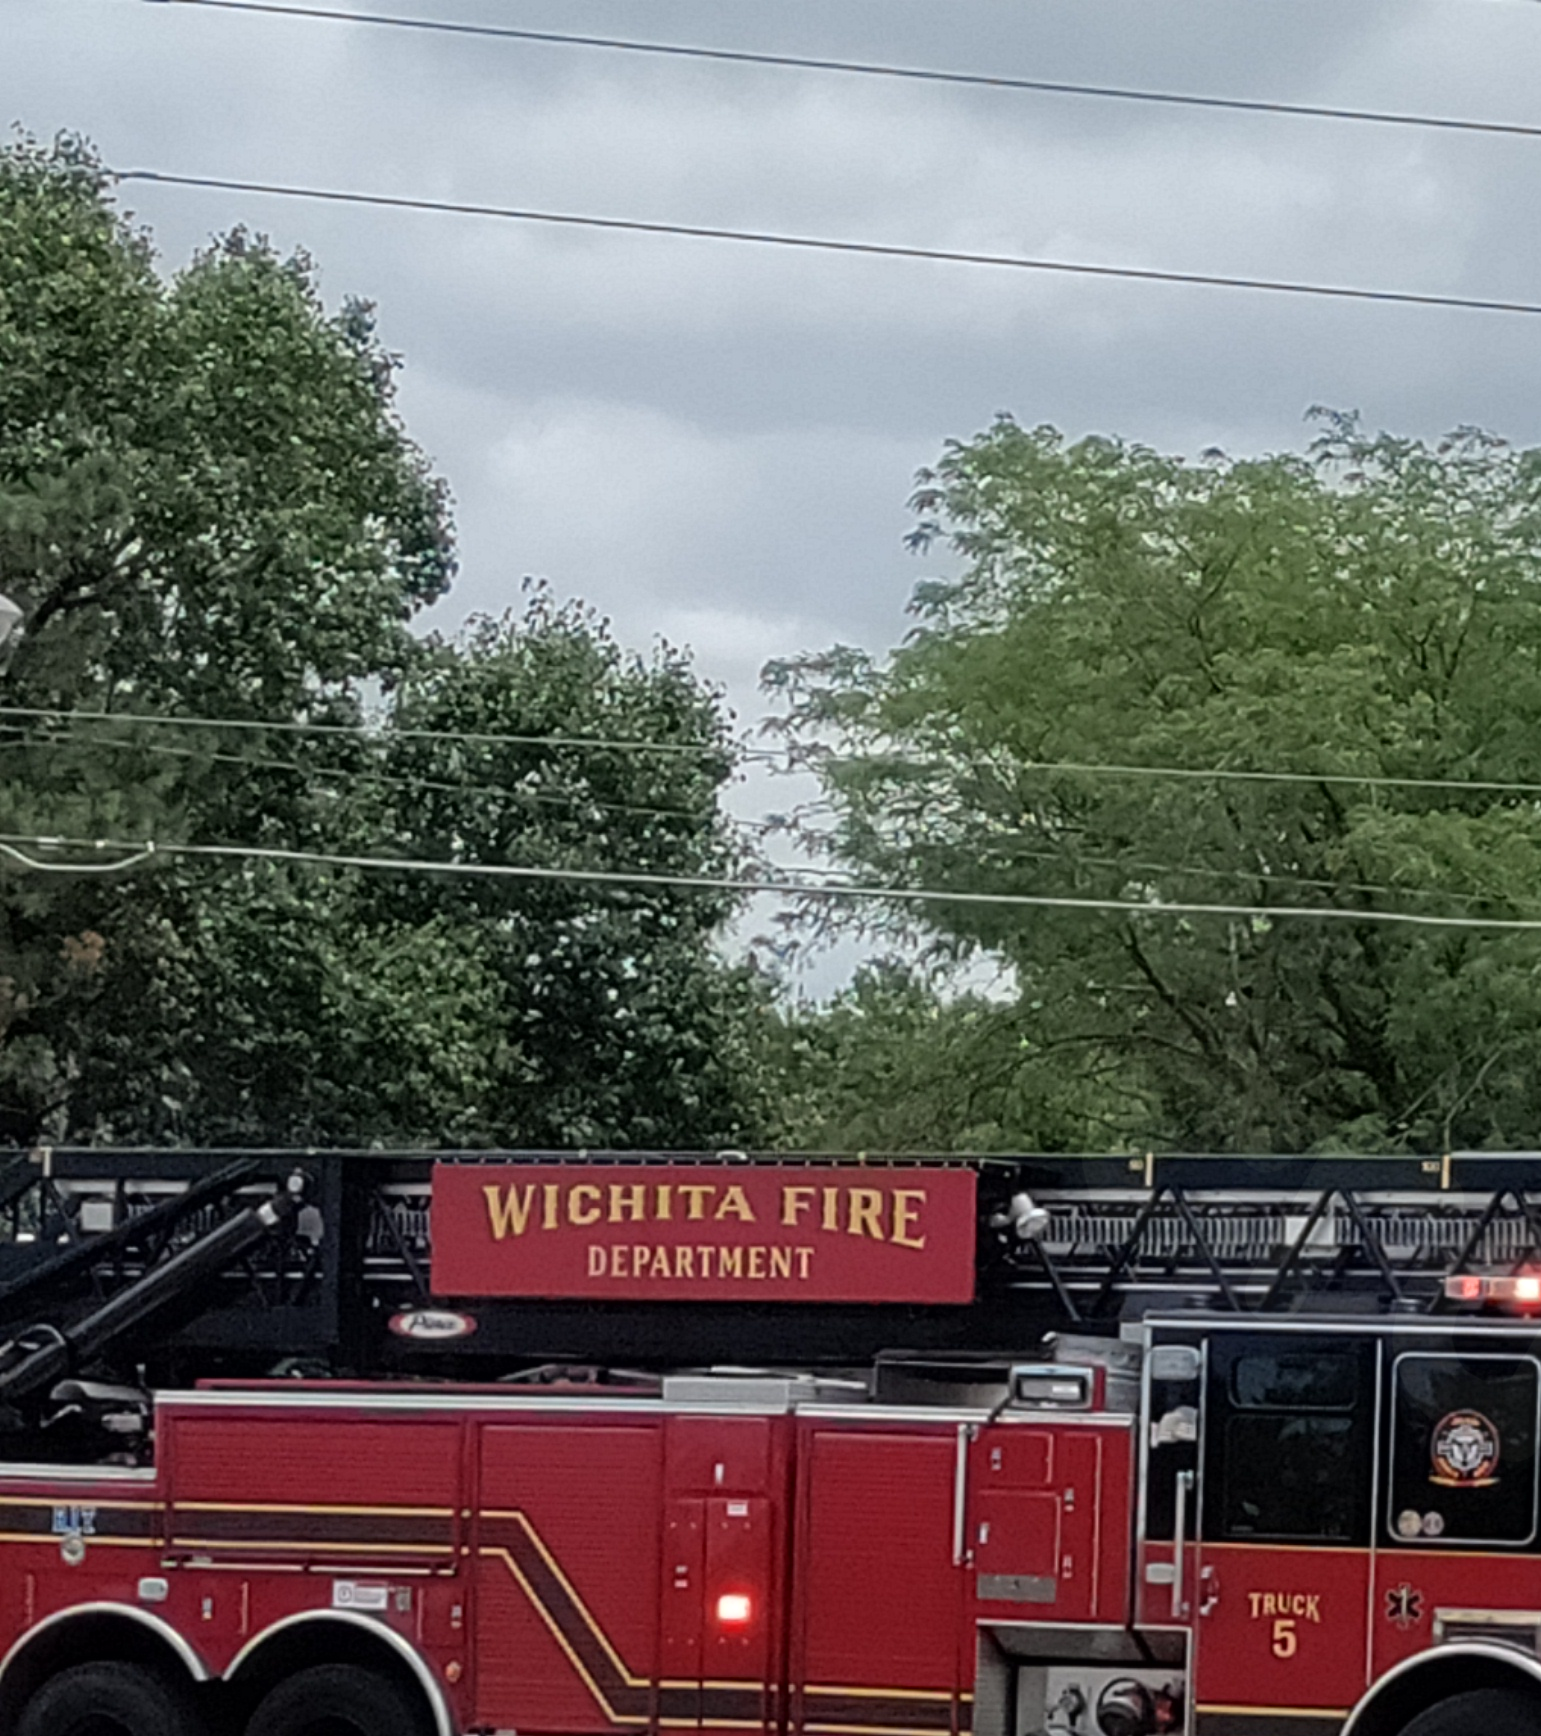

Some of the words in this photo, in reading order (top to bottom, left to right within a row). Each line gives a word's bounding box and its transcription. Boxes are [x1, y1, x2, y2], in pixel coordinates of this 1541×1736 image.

[483, 1184, 757, 1240] WICHITA
[781, 1186, 927, 1249] FIRE
[587, 1245, 815, 1280] DEPARTMENT
[1248, 1592, 1321, 1623] TRUCK
[1271, 1620, 1297, 1659] 5
